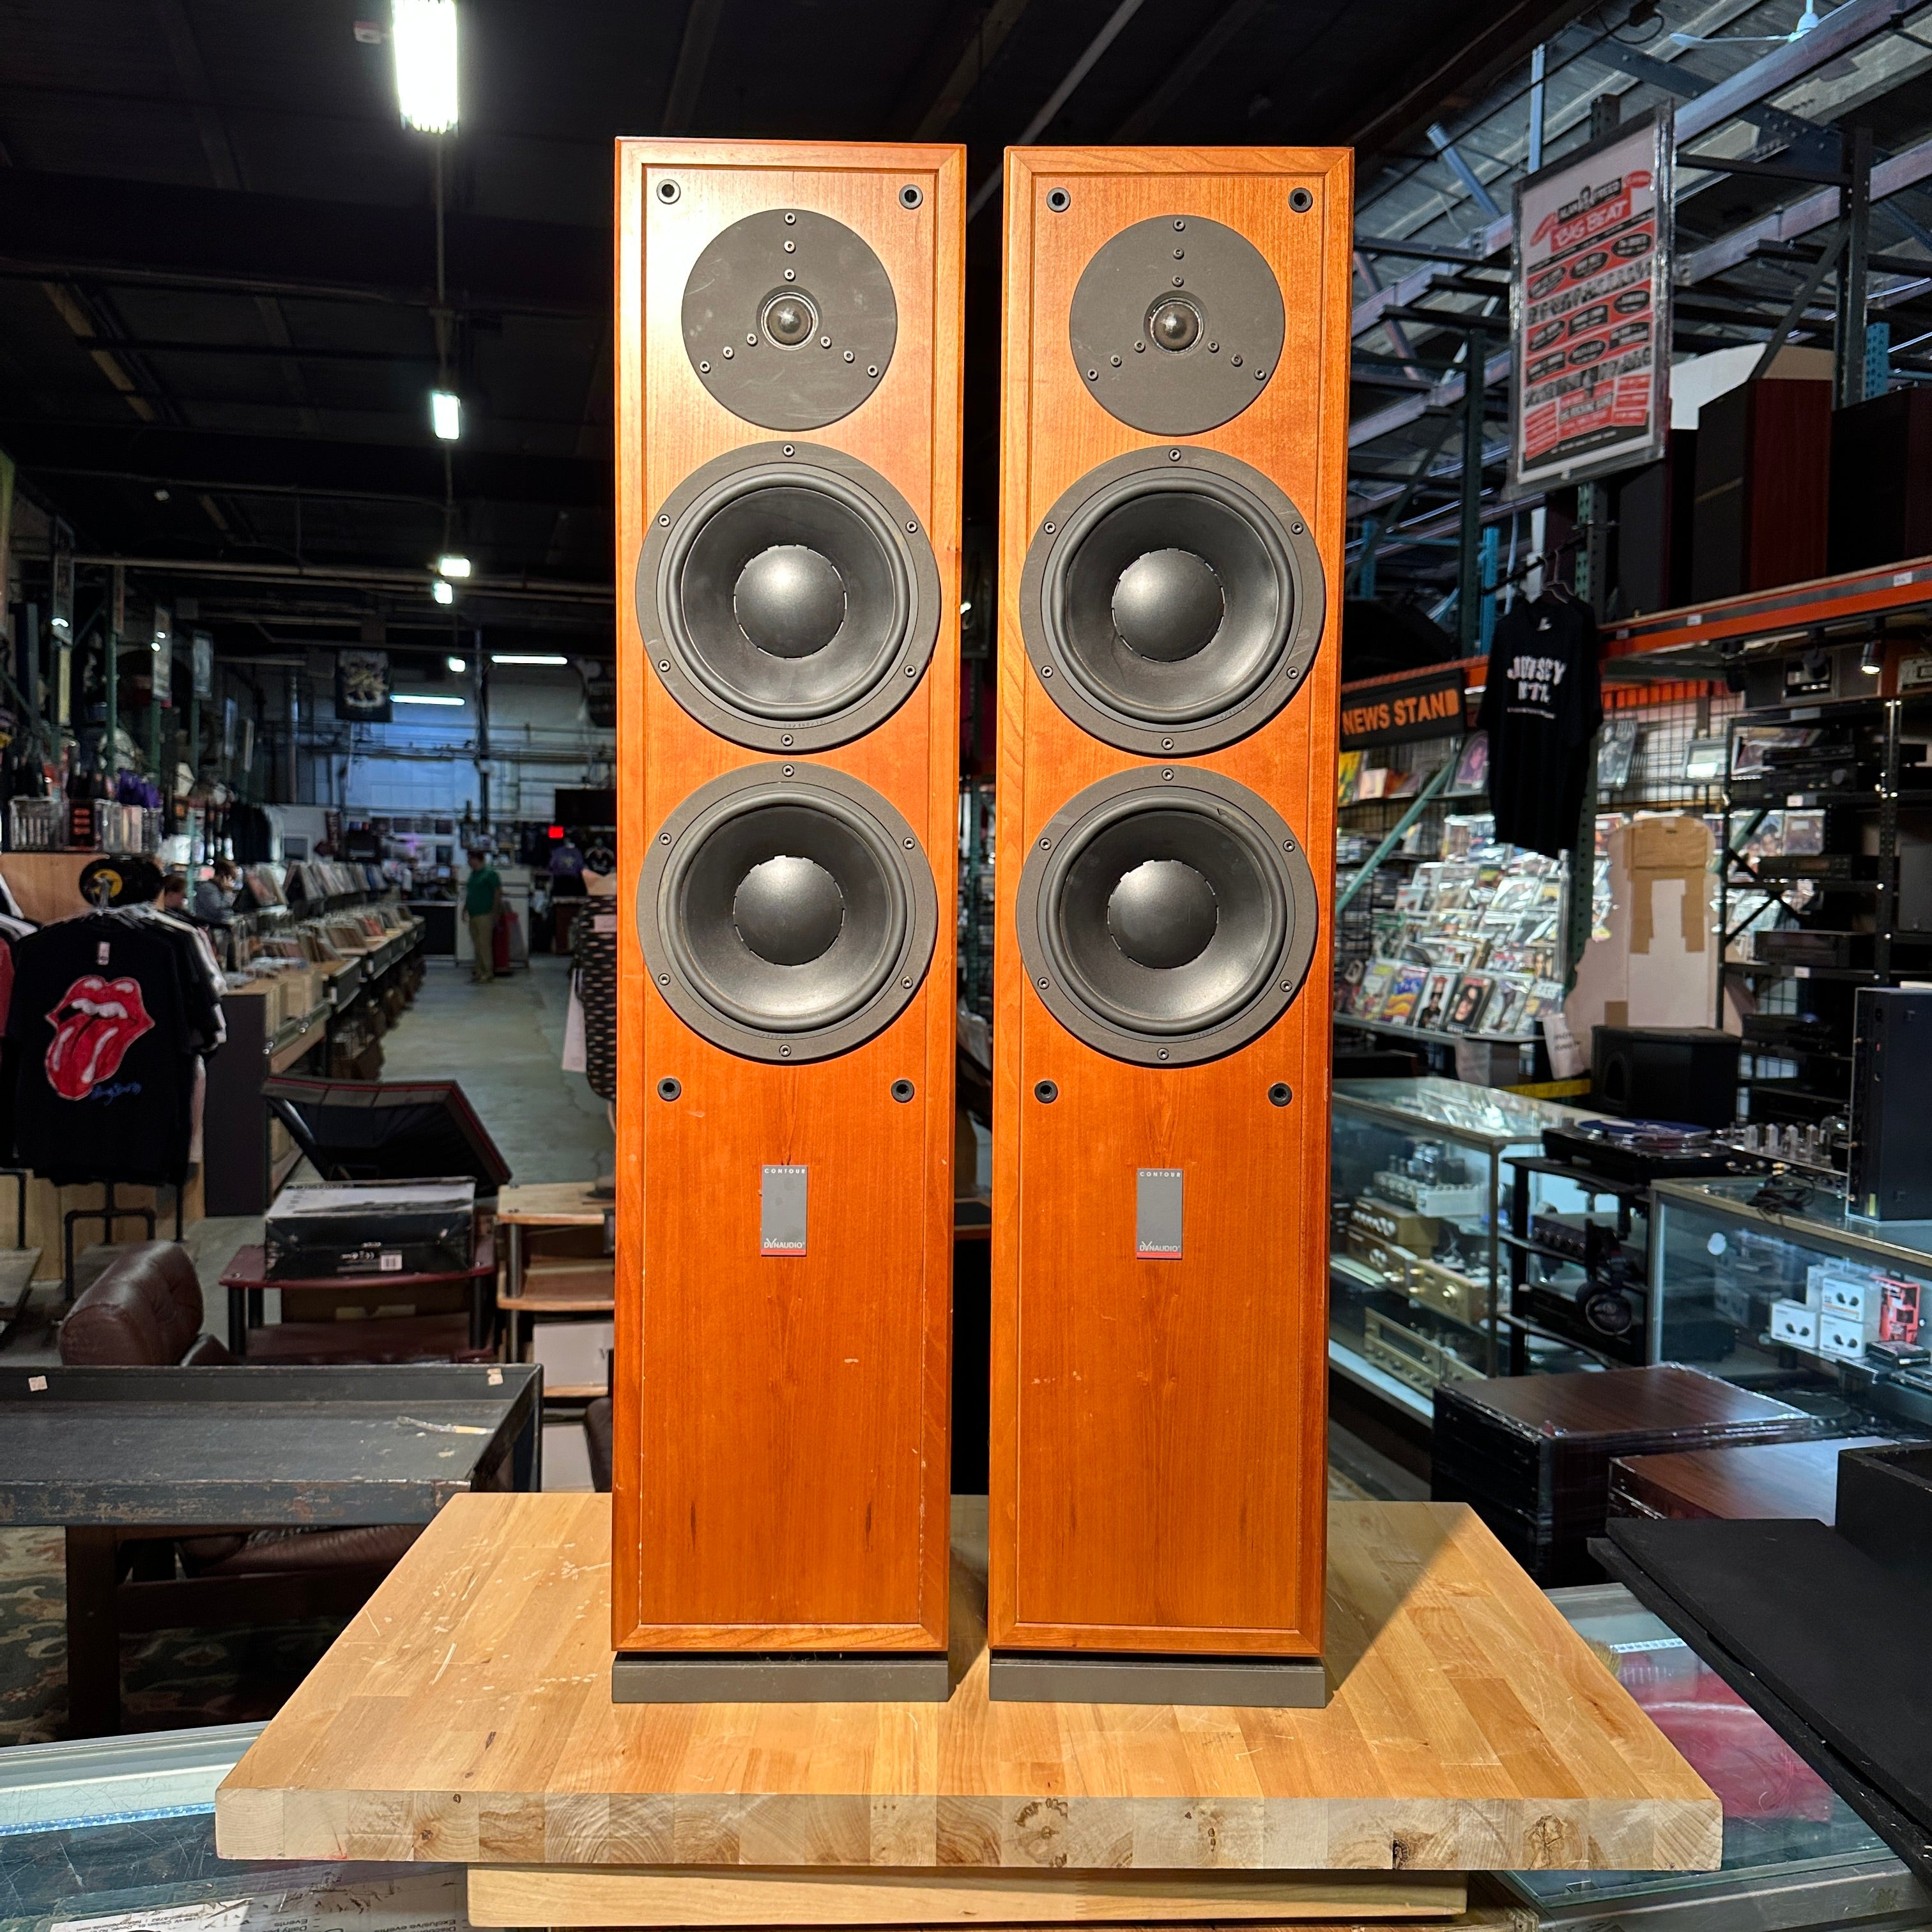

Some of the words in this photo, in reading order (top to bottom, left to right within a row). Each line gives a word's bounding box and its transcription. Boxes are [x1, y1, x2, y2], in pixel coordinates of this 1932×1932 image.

[1556, 219, 1585, 247] BIG
[1586, 199, 1629, 232] BEAT
[1342, 703, 1391, 735] NEWS
[1393, 687, 1460, 726] STAND
[763, 1238, 802, 1249] DYNAUDIO
[1139, 1241, 1178, 1252] DYNAUDIO
[274, 1919, 308, 1927] Events
[409, 1919, 456, 1929] Exclusive
